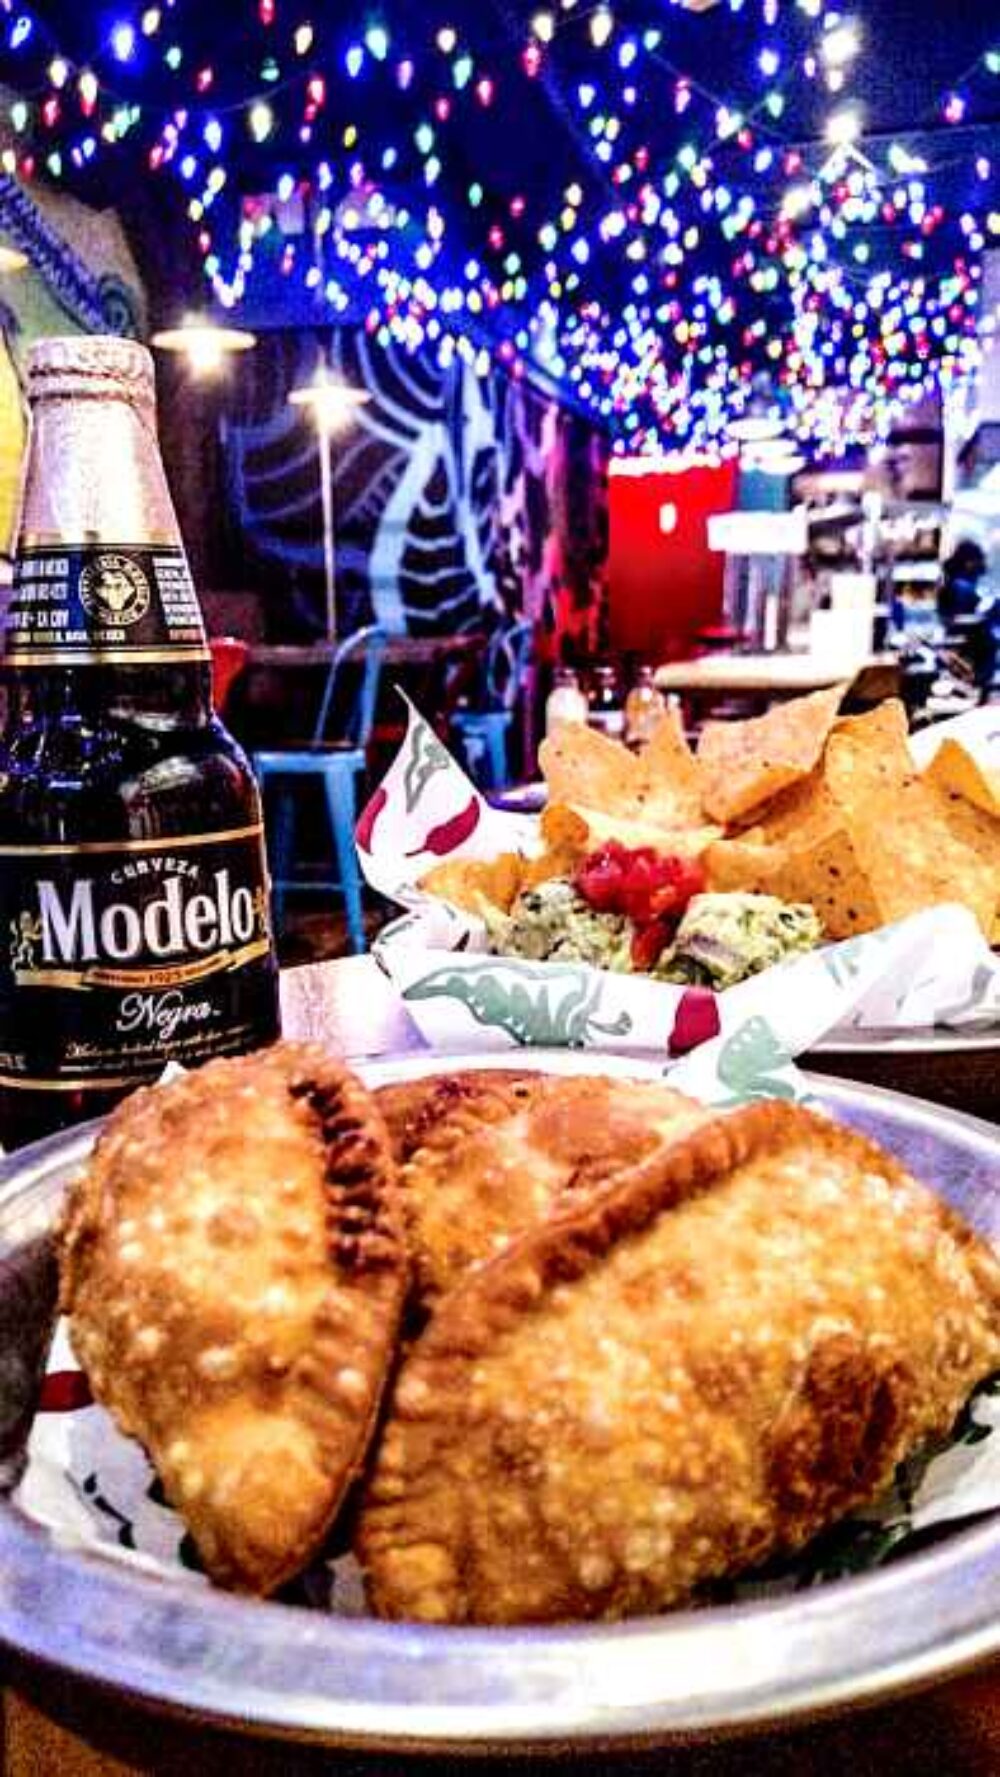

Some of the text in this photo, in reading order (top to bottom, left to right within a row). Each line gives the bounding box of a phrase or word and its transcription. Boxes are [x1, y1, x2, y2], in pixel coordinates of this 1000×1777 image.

[110, 857, 199, 884] CERVEZA
[36, 868, 254, 962] Modelo
[116, 989, 211, 1039] Negra
